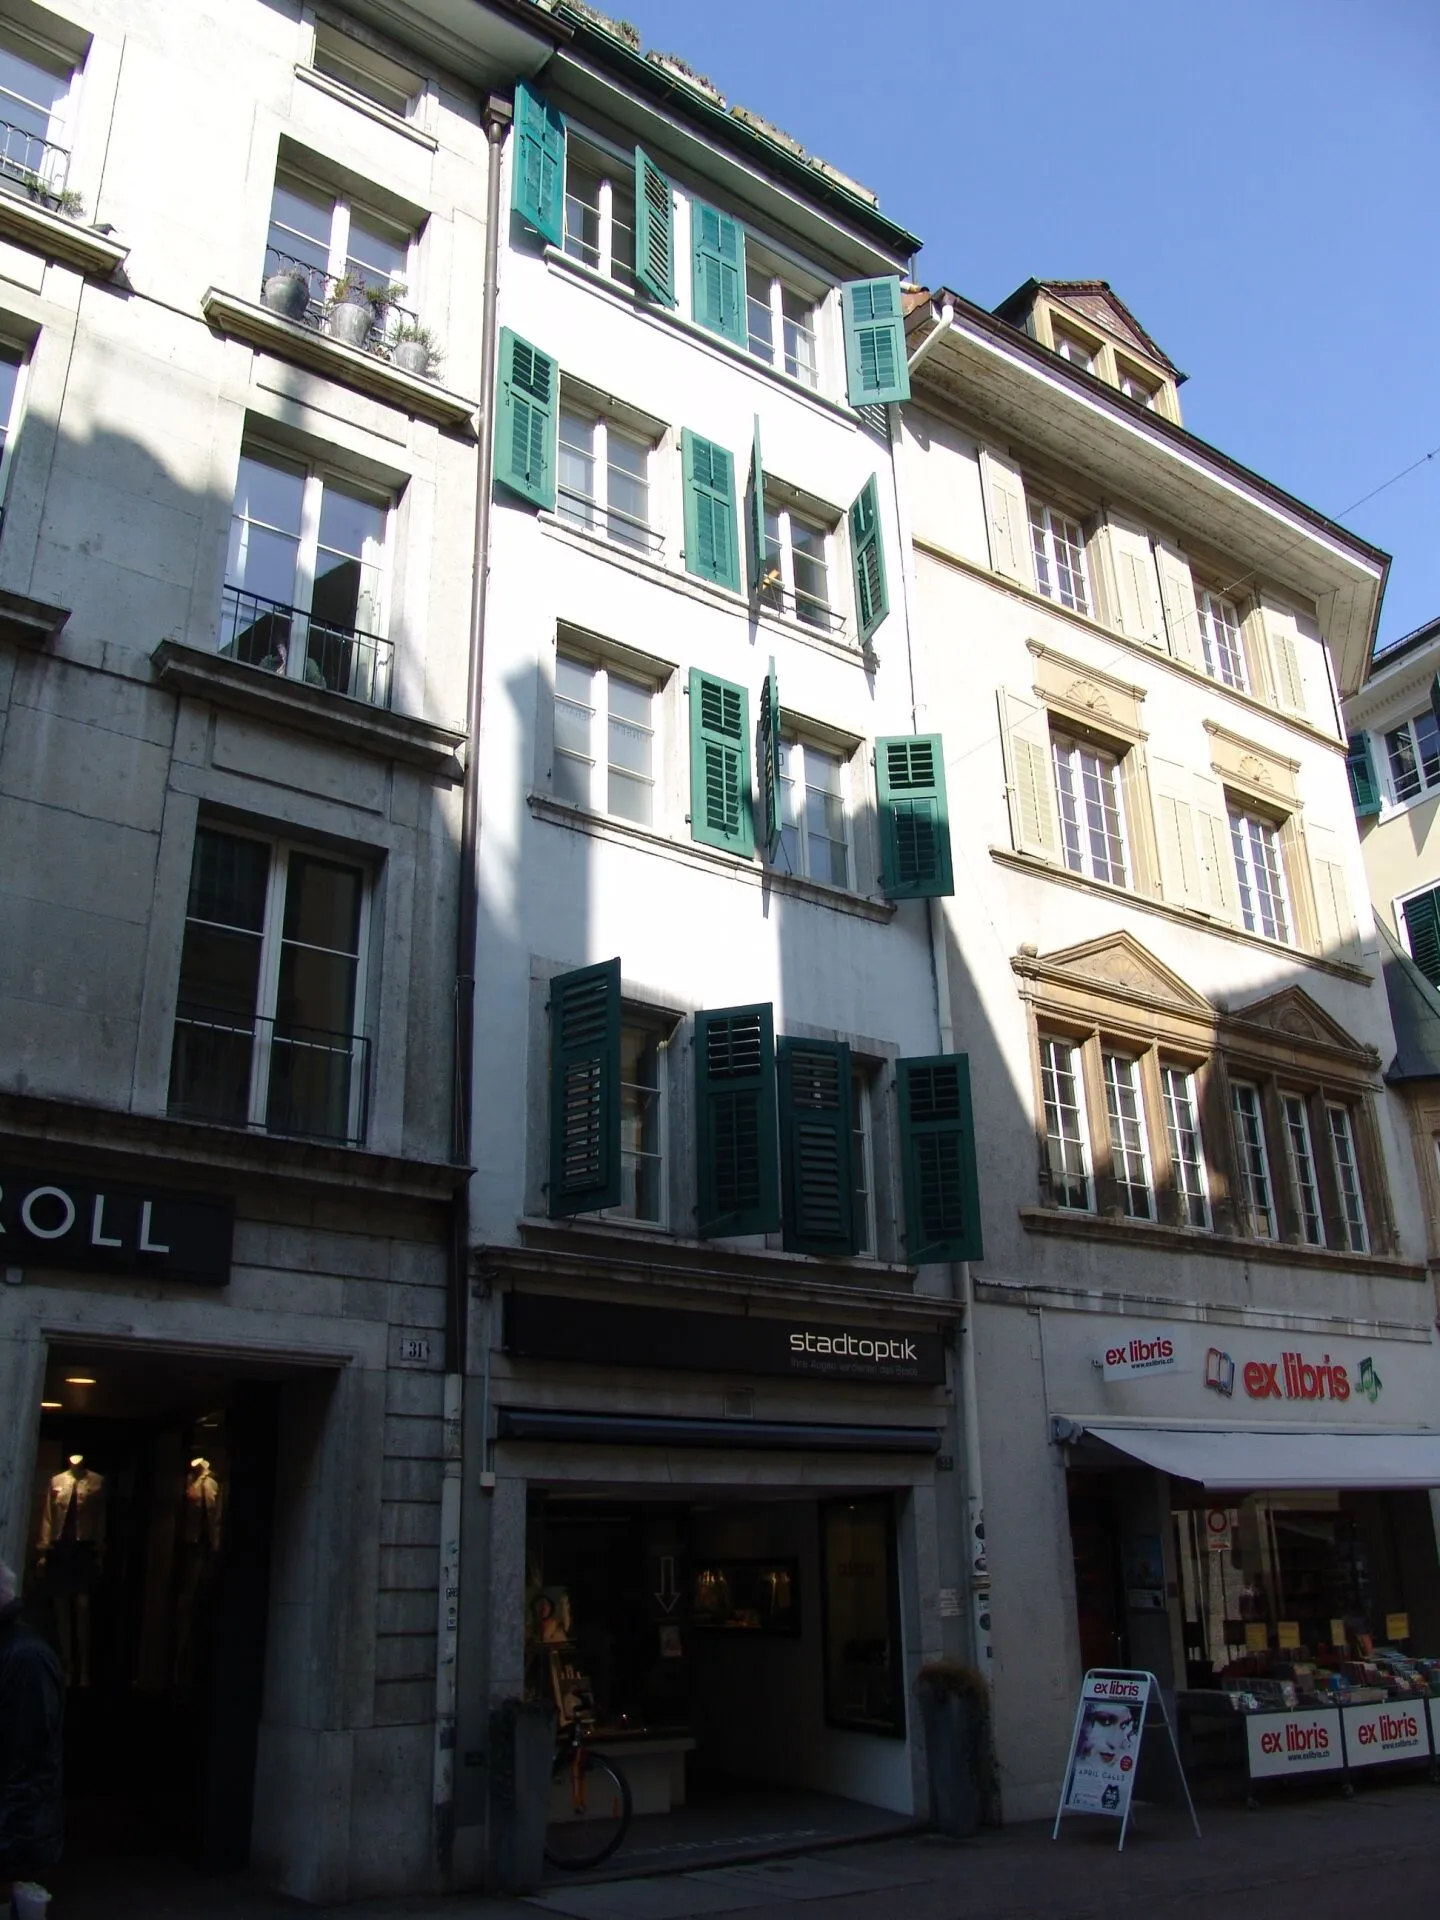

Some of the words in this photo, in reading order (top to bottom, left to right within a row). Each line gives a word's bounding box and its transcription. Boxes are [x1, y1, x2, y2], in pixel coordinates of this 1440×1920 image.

[0, 1185, 170, 1253] OLL
[409, 1341, 422, 1357] 31
[790, 1331, 918, 1362] stadtoptik
[1105, 1347, 1127, 1366] ex
[1129, 1336, 1173, 1362] libris
[1131, 1357, 1174, 1369] www.exlibris.ch
[1244, 1361, 1282, 1400] ex
[1280, 1352, 1350, 1401] libris
[1094, 1683, 1108, 1694] ex
[1109, 1680, 1139, 1696] libris
[1261, 1732, 1283, 1754] ex
[1286, 1721, 1329, 1752] libris
[1358, 1724, 1378, 1745] ex
[1379, 1711, 1418, 1742] libris
[1288, 1750, 1330, 1762] www.exlibris.ch
